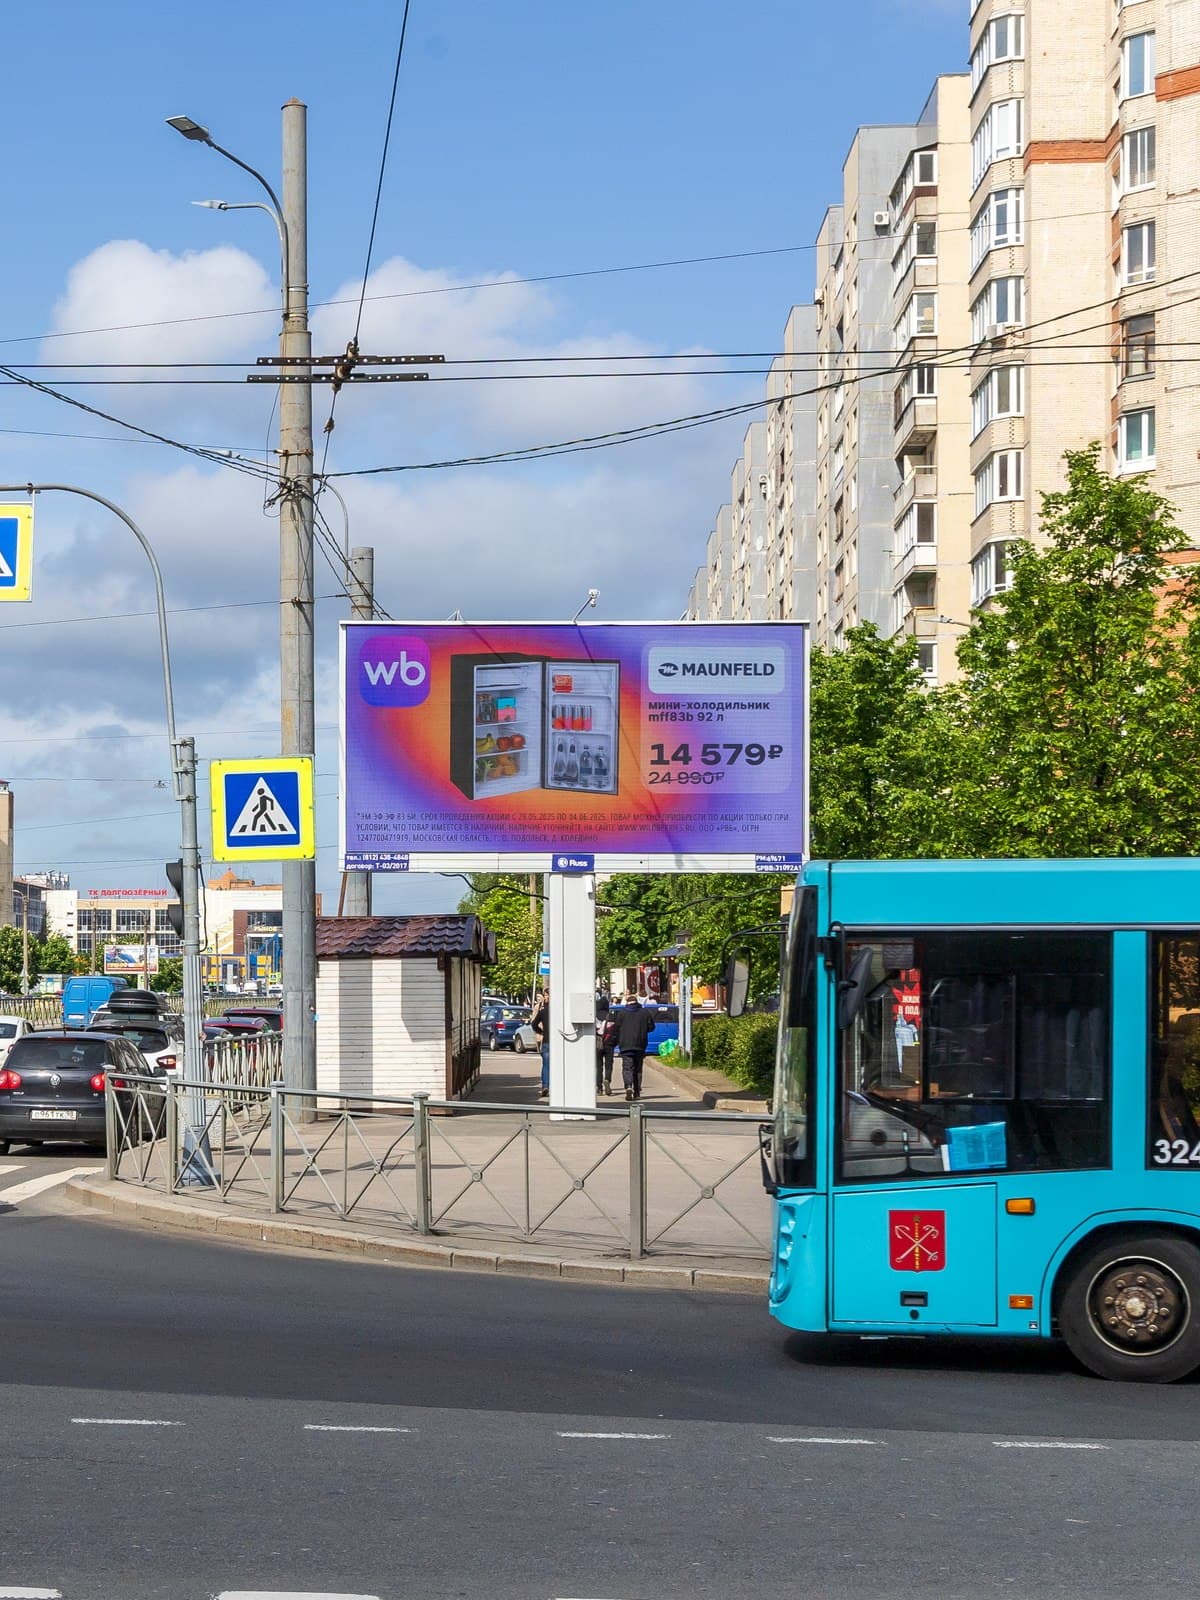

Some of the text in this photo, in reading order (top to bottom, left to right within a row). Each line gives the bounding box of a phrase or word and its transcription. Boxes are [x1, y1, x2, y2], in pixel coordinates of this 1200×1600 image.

[363, 650, 426, 686] wb
[682, 663, 775, 676] MAUNFELD
[648, 702, 770, 711] мини-холодильник
[648, 711, 724, 722] mff83b 92 л
[650, 743, 692, 766] 14
[648, 771, 672, 784] 24
[569, 859, 588, 867] Russ
